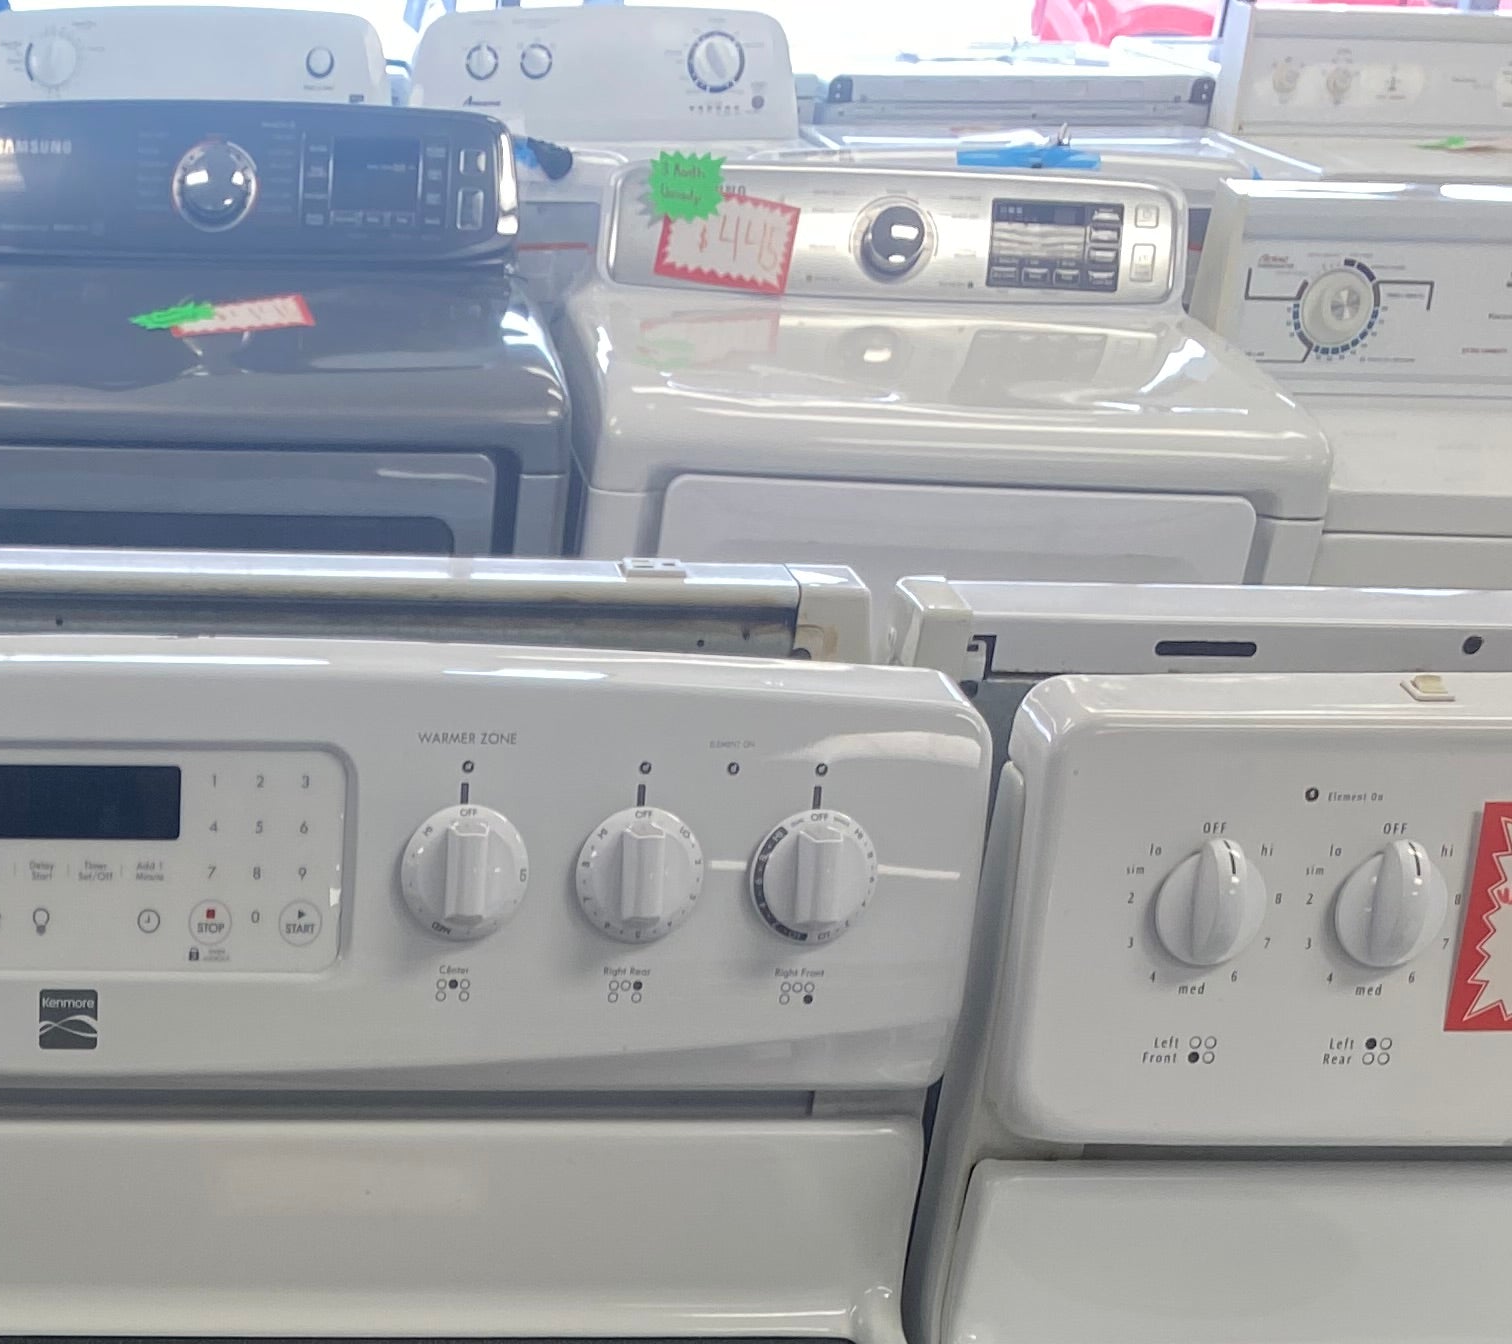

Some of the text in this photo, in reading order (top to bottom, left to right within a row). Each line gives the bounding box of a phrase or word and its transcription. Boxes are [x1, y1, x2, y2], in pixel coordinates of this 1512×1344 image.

[418, 732, 517, 745] WARMER ZONE
[212, 774, 310, 789] 1 2 3
[459, 808, 478, 817] OFF
[635, 810, 653, 818] OFF
[810, 813, 829, 822] OFF
[209, 820, 308, 834] 4 5 6
[1203, 822, 1227, 834] OFF
[1383, 822, 1408, 835] OFF
[1261, 844, 1274, 856] hi
[1441, 844, 1454, 857] hi
[207, 866, 307, 880] 7 8 9
[1306, 866, 1325, 876] sim
[1127, 893, 1135, 904] 2
[1275, 893, 1282, 904] 8
[1306, 893, 1314, 905] 2
[1454, 893, 1461, 905] 8
[251, 910, 260, 924] 0
[197, 923, 225, 933] STOP
[285, 923, 315, 934] START
[1127, 937, 1134, 949] 3
[1264, 938, 1271, 949] 7
[1305, 938, 1312, 950] 3
[1442, 938, 1449, 950] 7
[603, 967, 651, 977] Right Rear
[774, 968, 825, 978] Right Front
[1149, 971, 1156, 983] 4
[1231, 971, 1238, 982] 6
[1326, 972, 1333, 984] 4
[1408, 971, 1416, 983] 6
[1178, 983, 1206, 995] med
[1355, 983, 1382, 996] med
[42, 997, 94, 1008] Kenmore
[1154, 1037, 1179, 1049] Left
[1329, 1038, 1354, 1050] Left
[1142, 1052, 1177, 1064] Front
[1323, 1053, 1352, 1065] Rear
